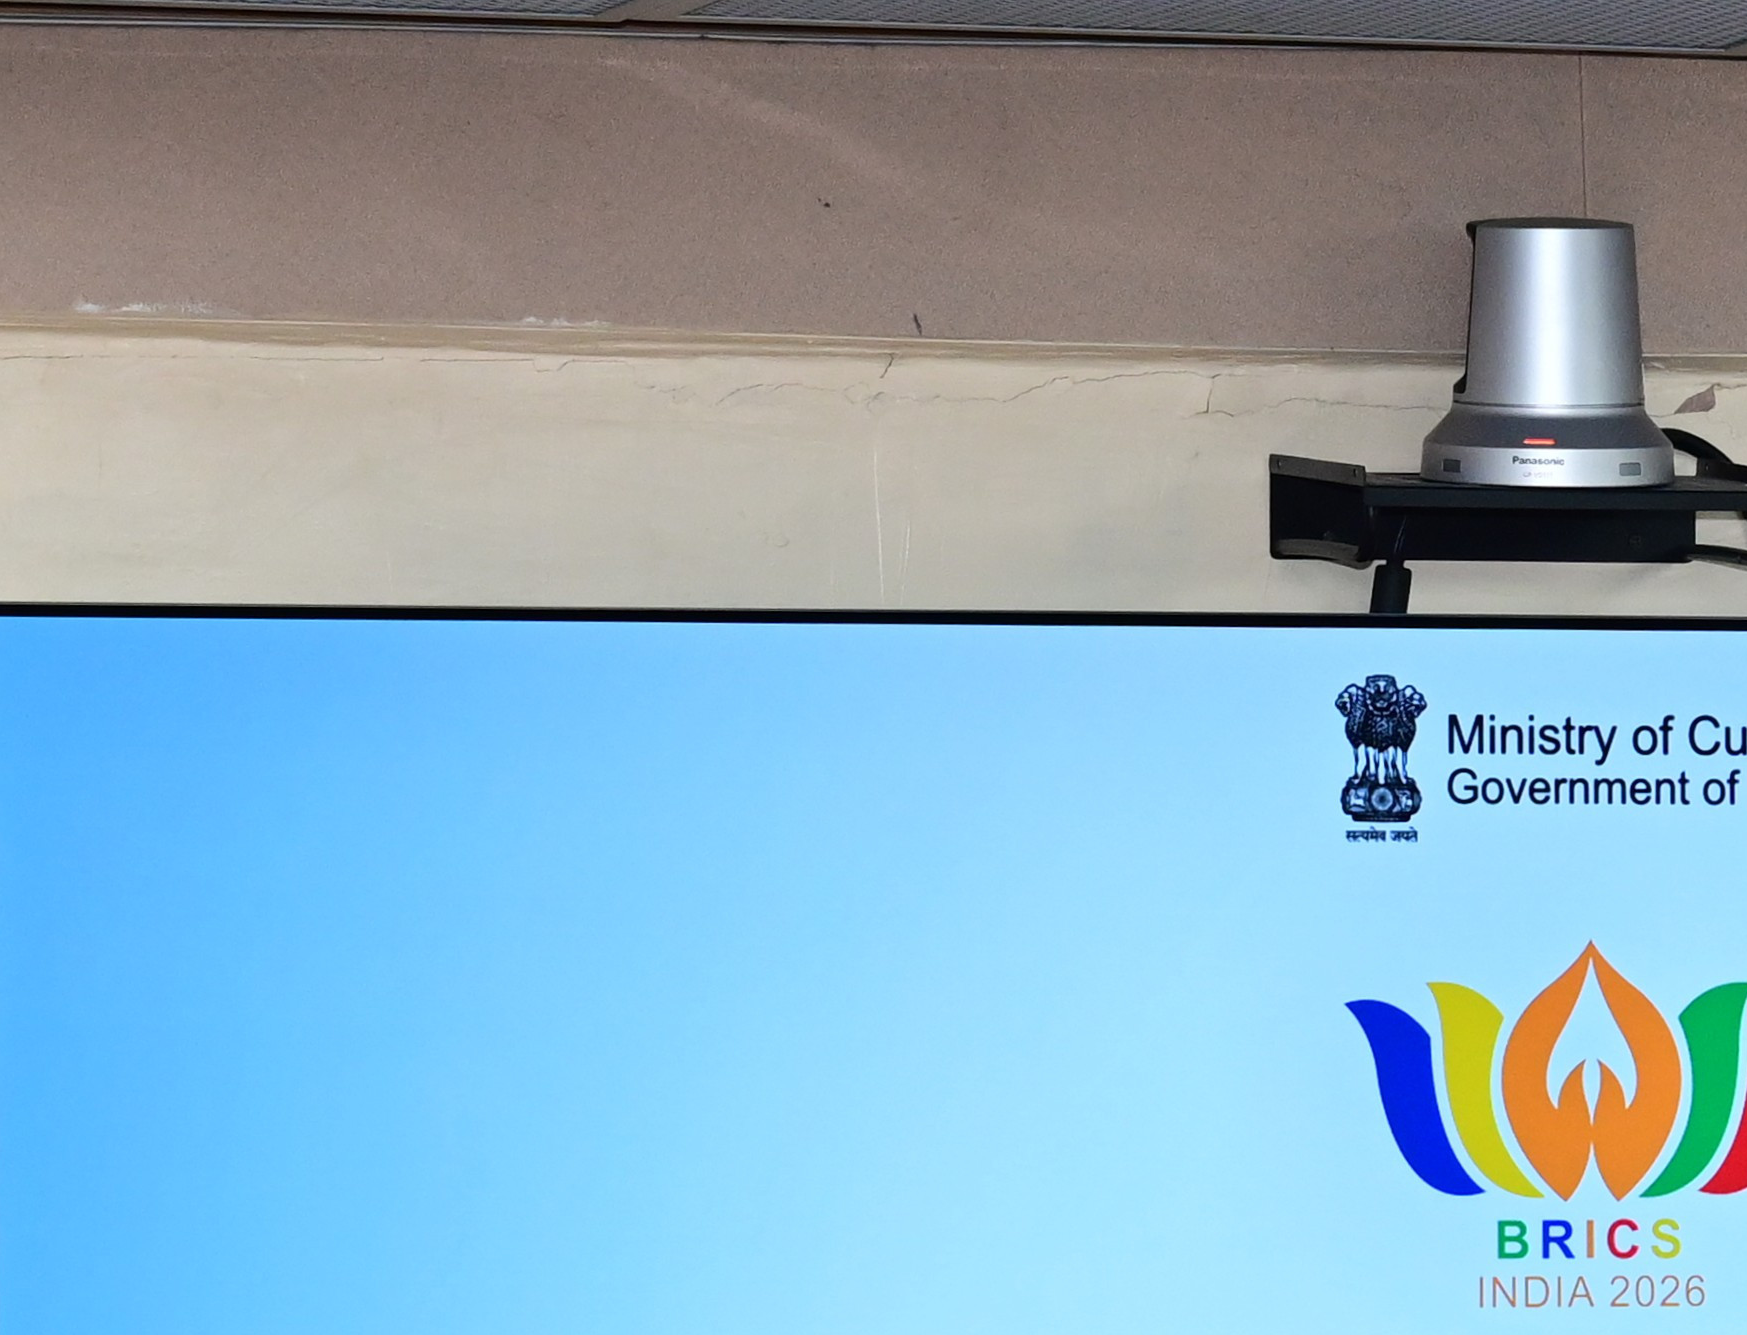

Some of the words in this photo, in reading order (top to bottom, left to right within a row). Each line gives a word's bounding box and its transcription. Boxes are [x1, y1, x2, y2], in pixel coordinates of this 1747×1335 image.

[1512, 455, 1565, 466] Panasonic
[1447, 713, 1618, 773] Ministry
[1632, 714, 1676, 756] of
[1447, 767, 1691, 806] Government
[1703, 768, 1742, 807] of
[1496, 1217, 1682, 1260] BRICS
[1479, 1275, 1595, 1309] INDIA
[1609, 1274, 1706, 1309] 2026
